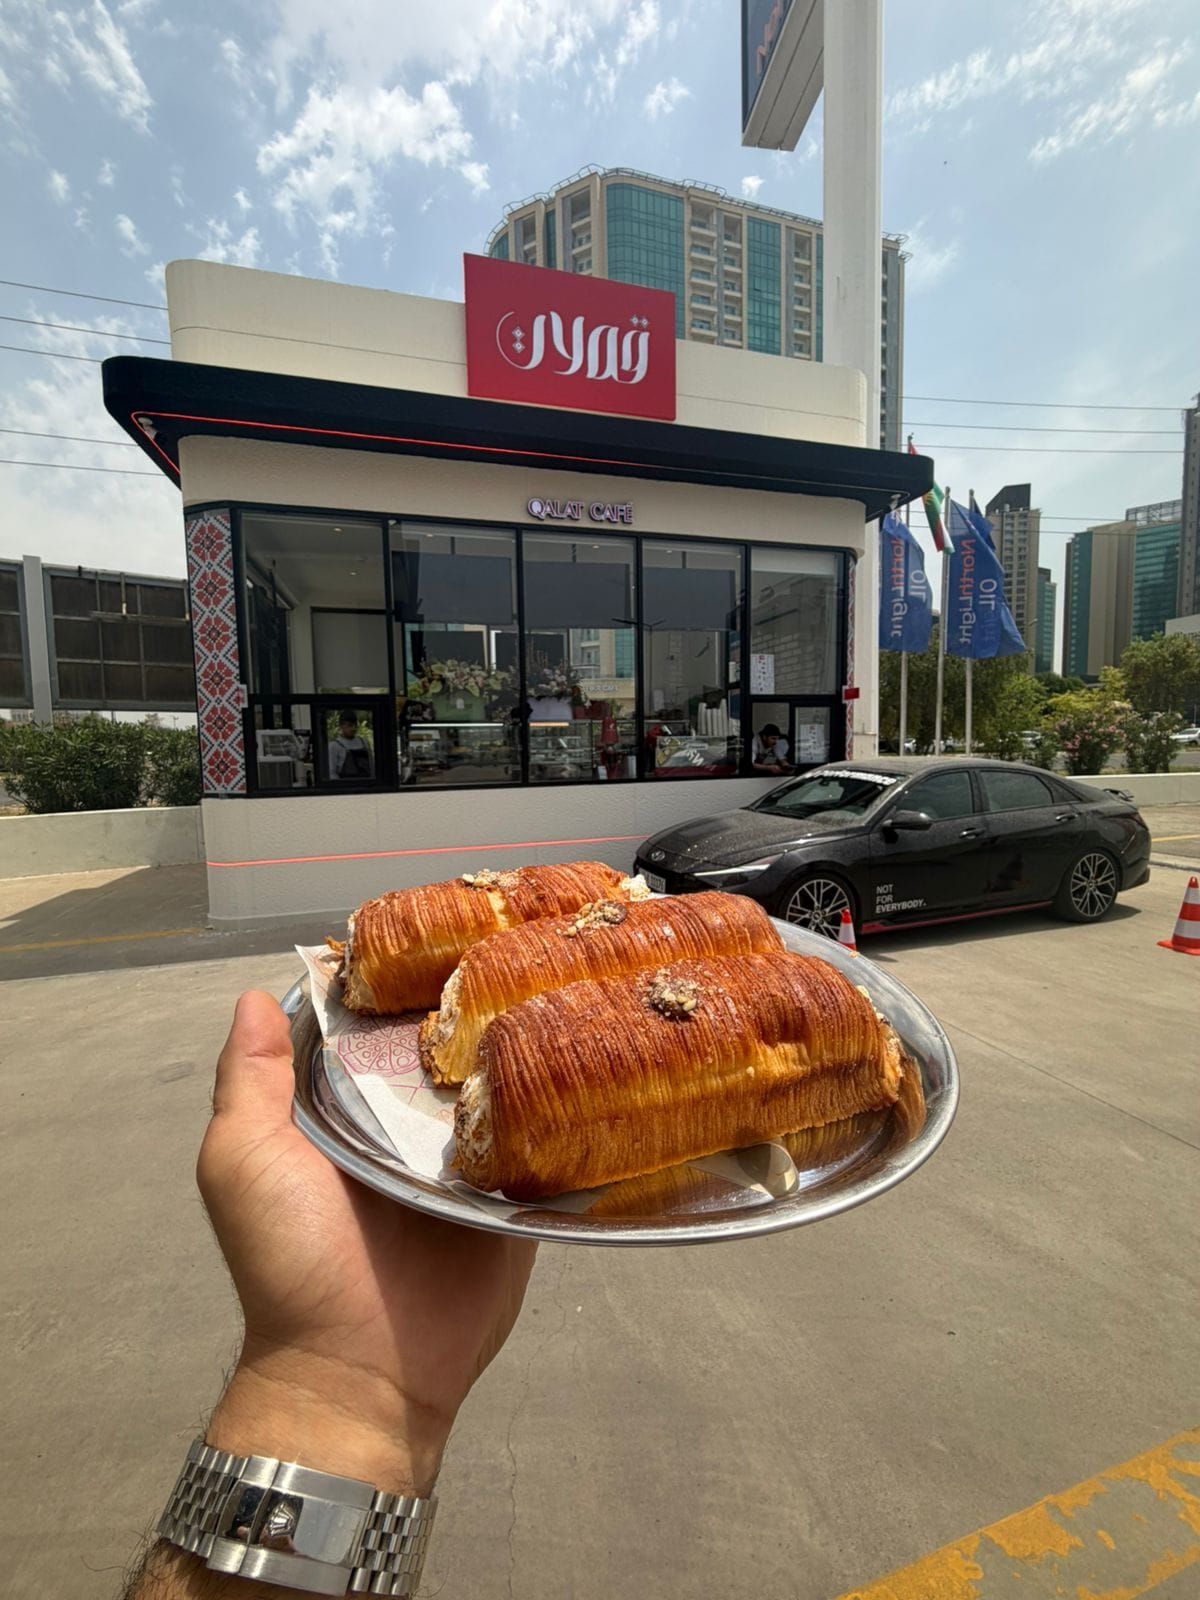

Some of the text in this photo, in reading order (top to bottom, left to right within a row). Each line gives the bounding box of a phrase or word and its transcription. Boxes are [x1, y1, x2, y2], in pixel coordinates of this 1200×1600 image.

[527, 498, 584, 520] QALAT
[876, 884, 893, 894] NOT
[876, 894, 893, 904] FOR
[875, 899, 927, 914] EVERYBODY.
